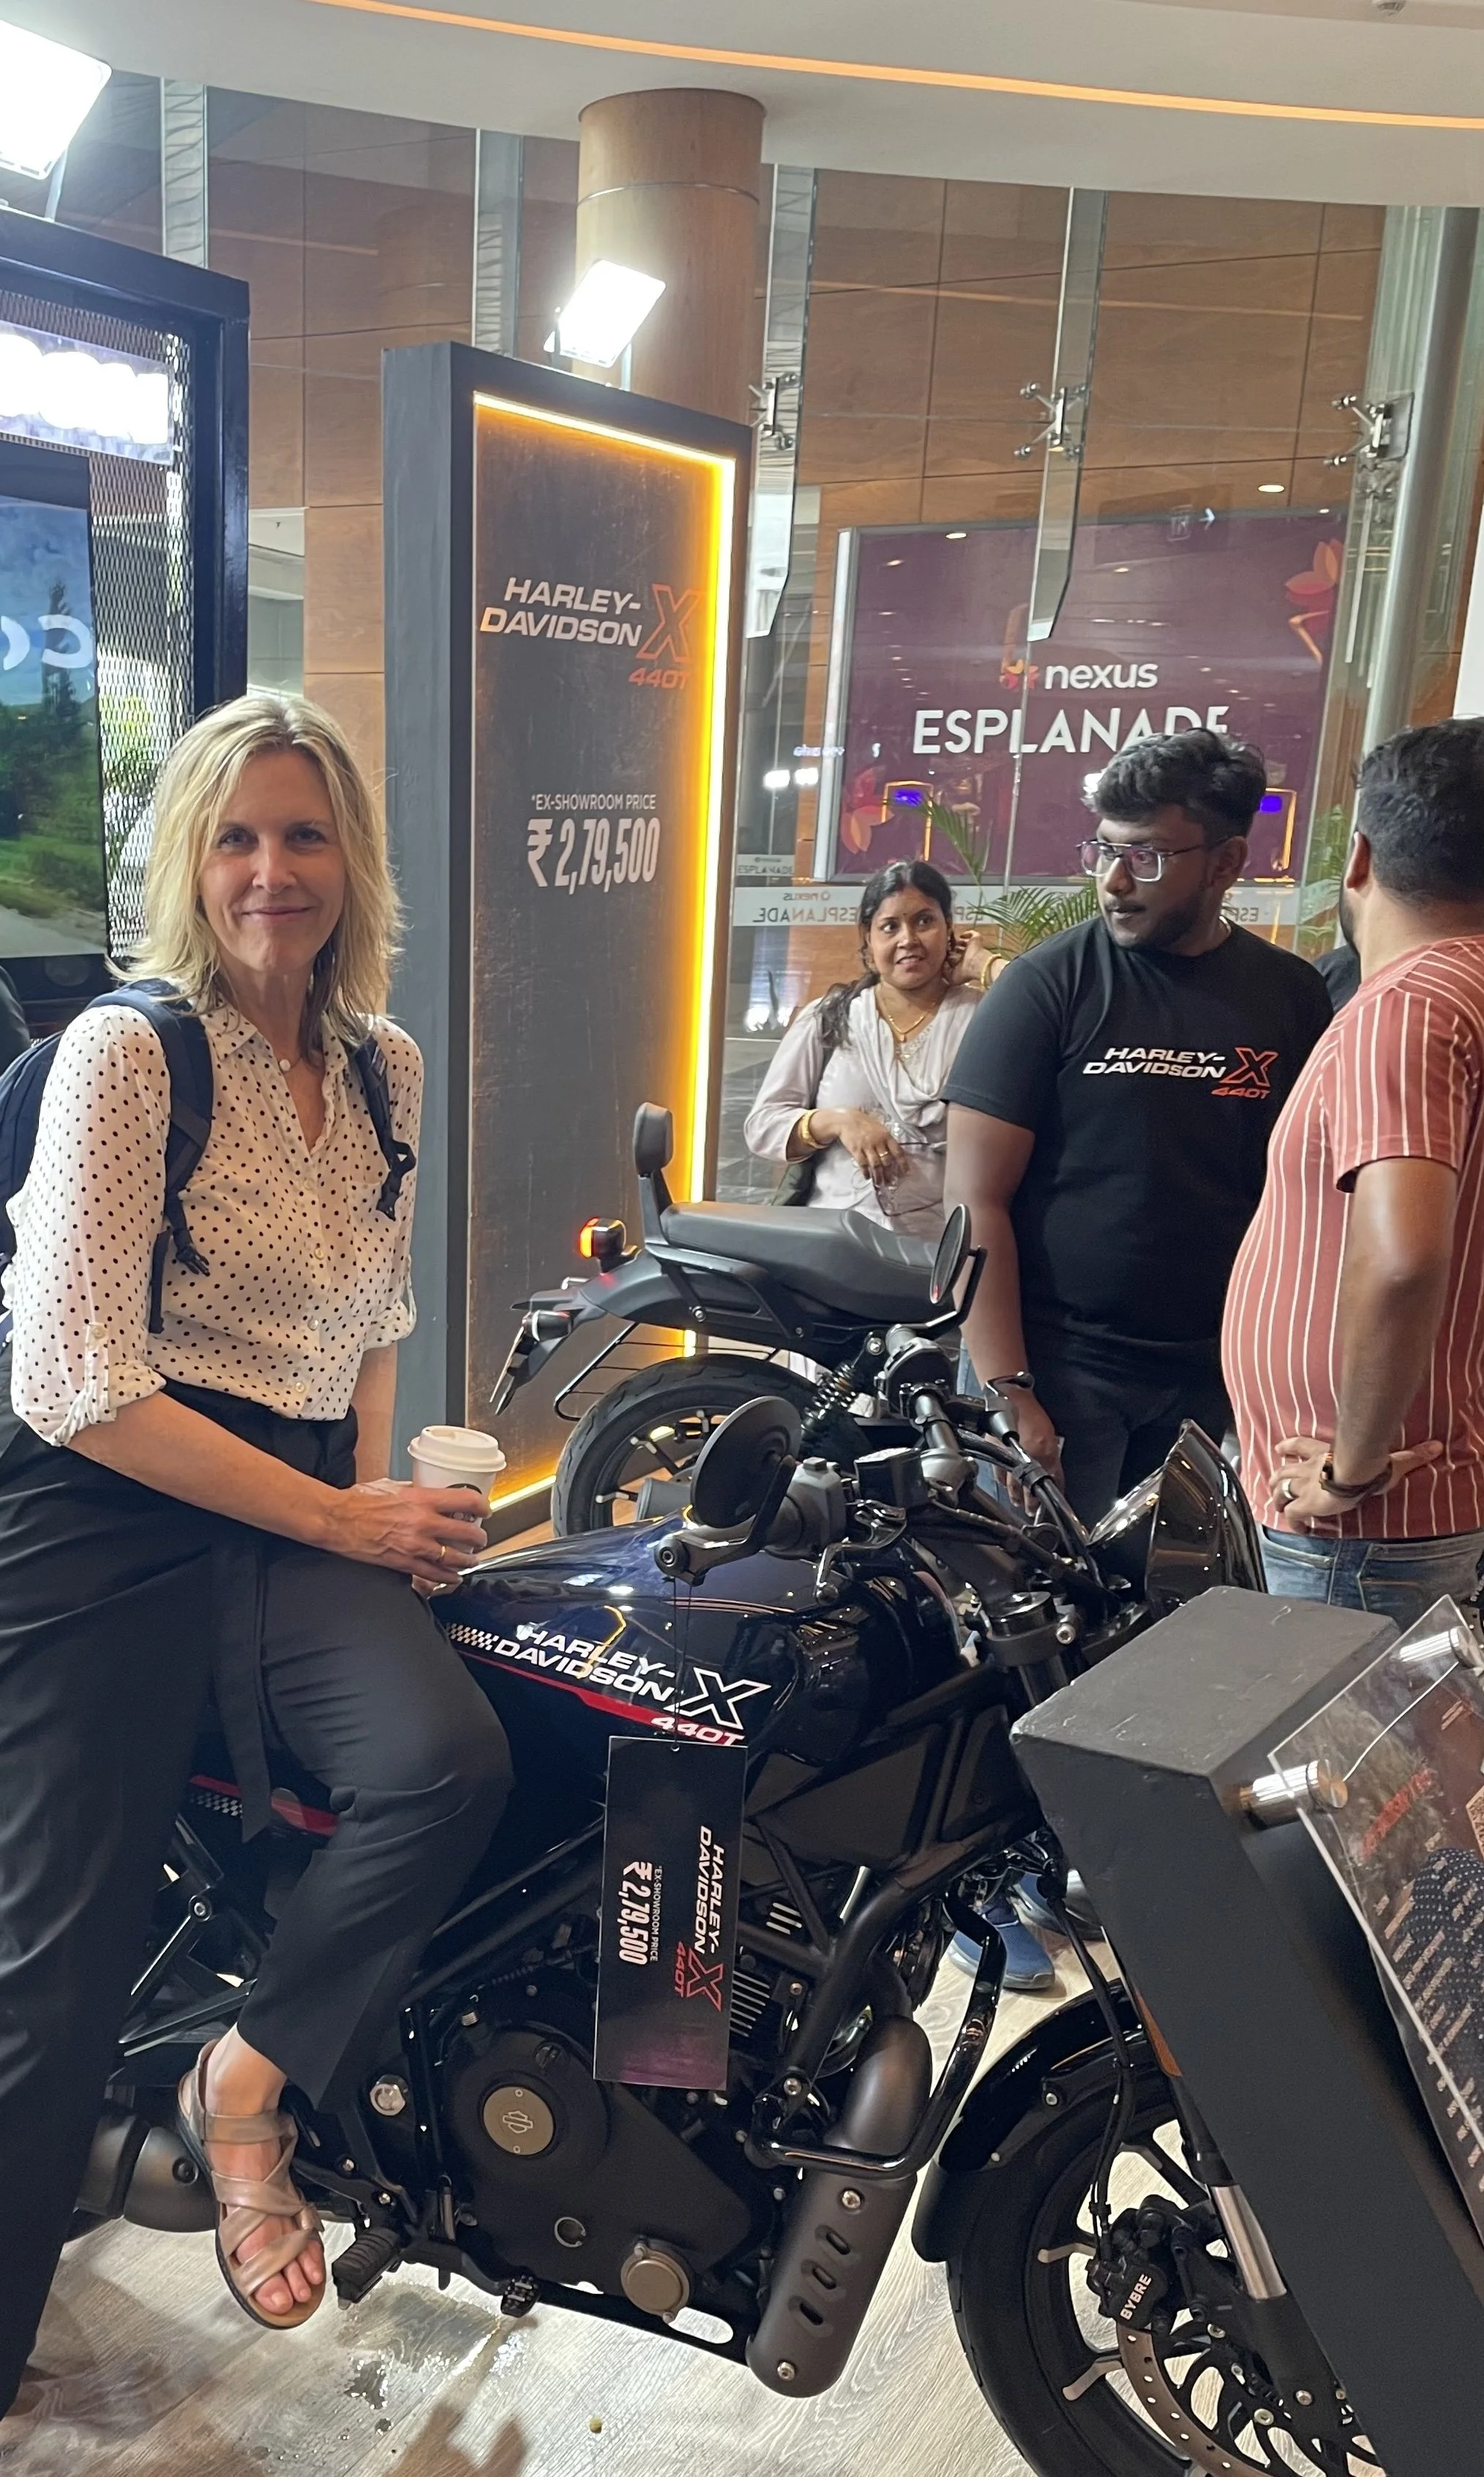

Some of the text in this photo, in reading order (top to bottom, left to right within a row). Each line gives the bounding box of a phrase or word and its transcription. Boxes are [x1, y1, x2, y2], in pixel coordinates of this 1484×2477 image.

[504, 578, 641, 615] HARLEY-
[479, 607, 642, 646] DAVIDSON
[629, 667, 691, 690] 440T
[1045, 662, 1158, 690] nexus
[912, 706, 1229, 755] ESPLANADE
[626, 793, 656, 810] PRICE
[1082, 1061, 1226, 1078] DAVIDSON
[1103, 1047, 1226, 1064] HARLEY-
[1219, 1046, 1279, 1088] X
[1211, 1087, 1270, 1099] 440T
[494, 1638, 677, 1703] DAVIDSON
[523, 1630, 675, 1678] HARLEY-
[664, 1667, 773, 1730] X
[651, 1716, 745, 1746] 440T
[694, 1825, 711, 1954] DAVIDSON
[708, 1844, 724, 1954] HARLEY-
[650, 1936, 659, 1962] PRICE
[675, 1940, 686, 1998] 440T
[1120, 2273, 1152, 2320] BYBRE
